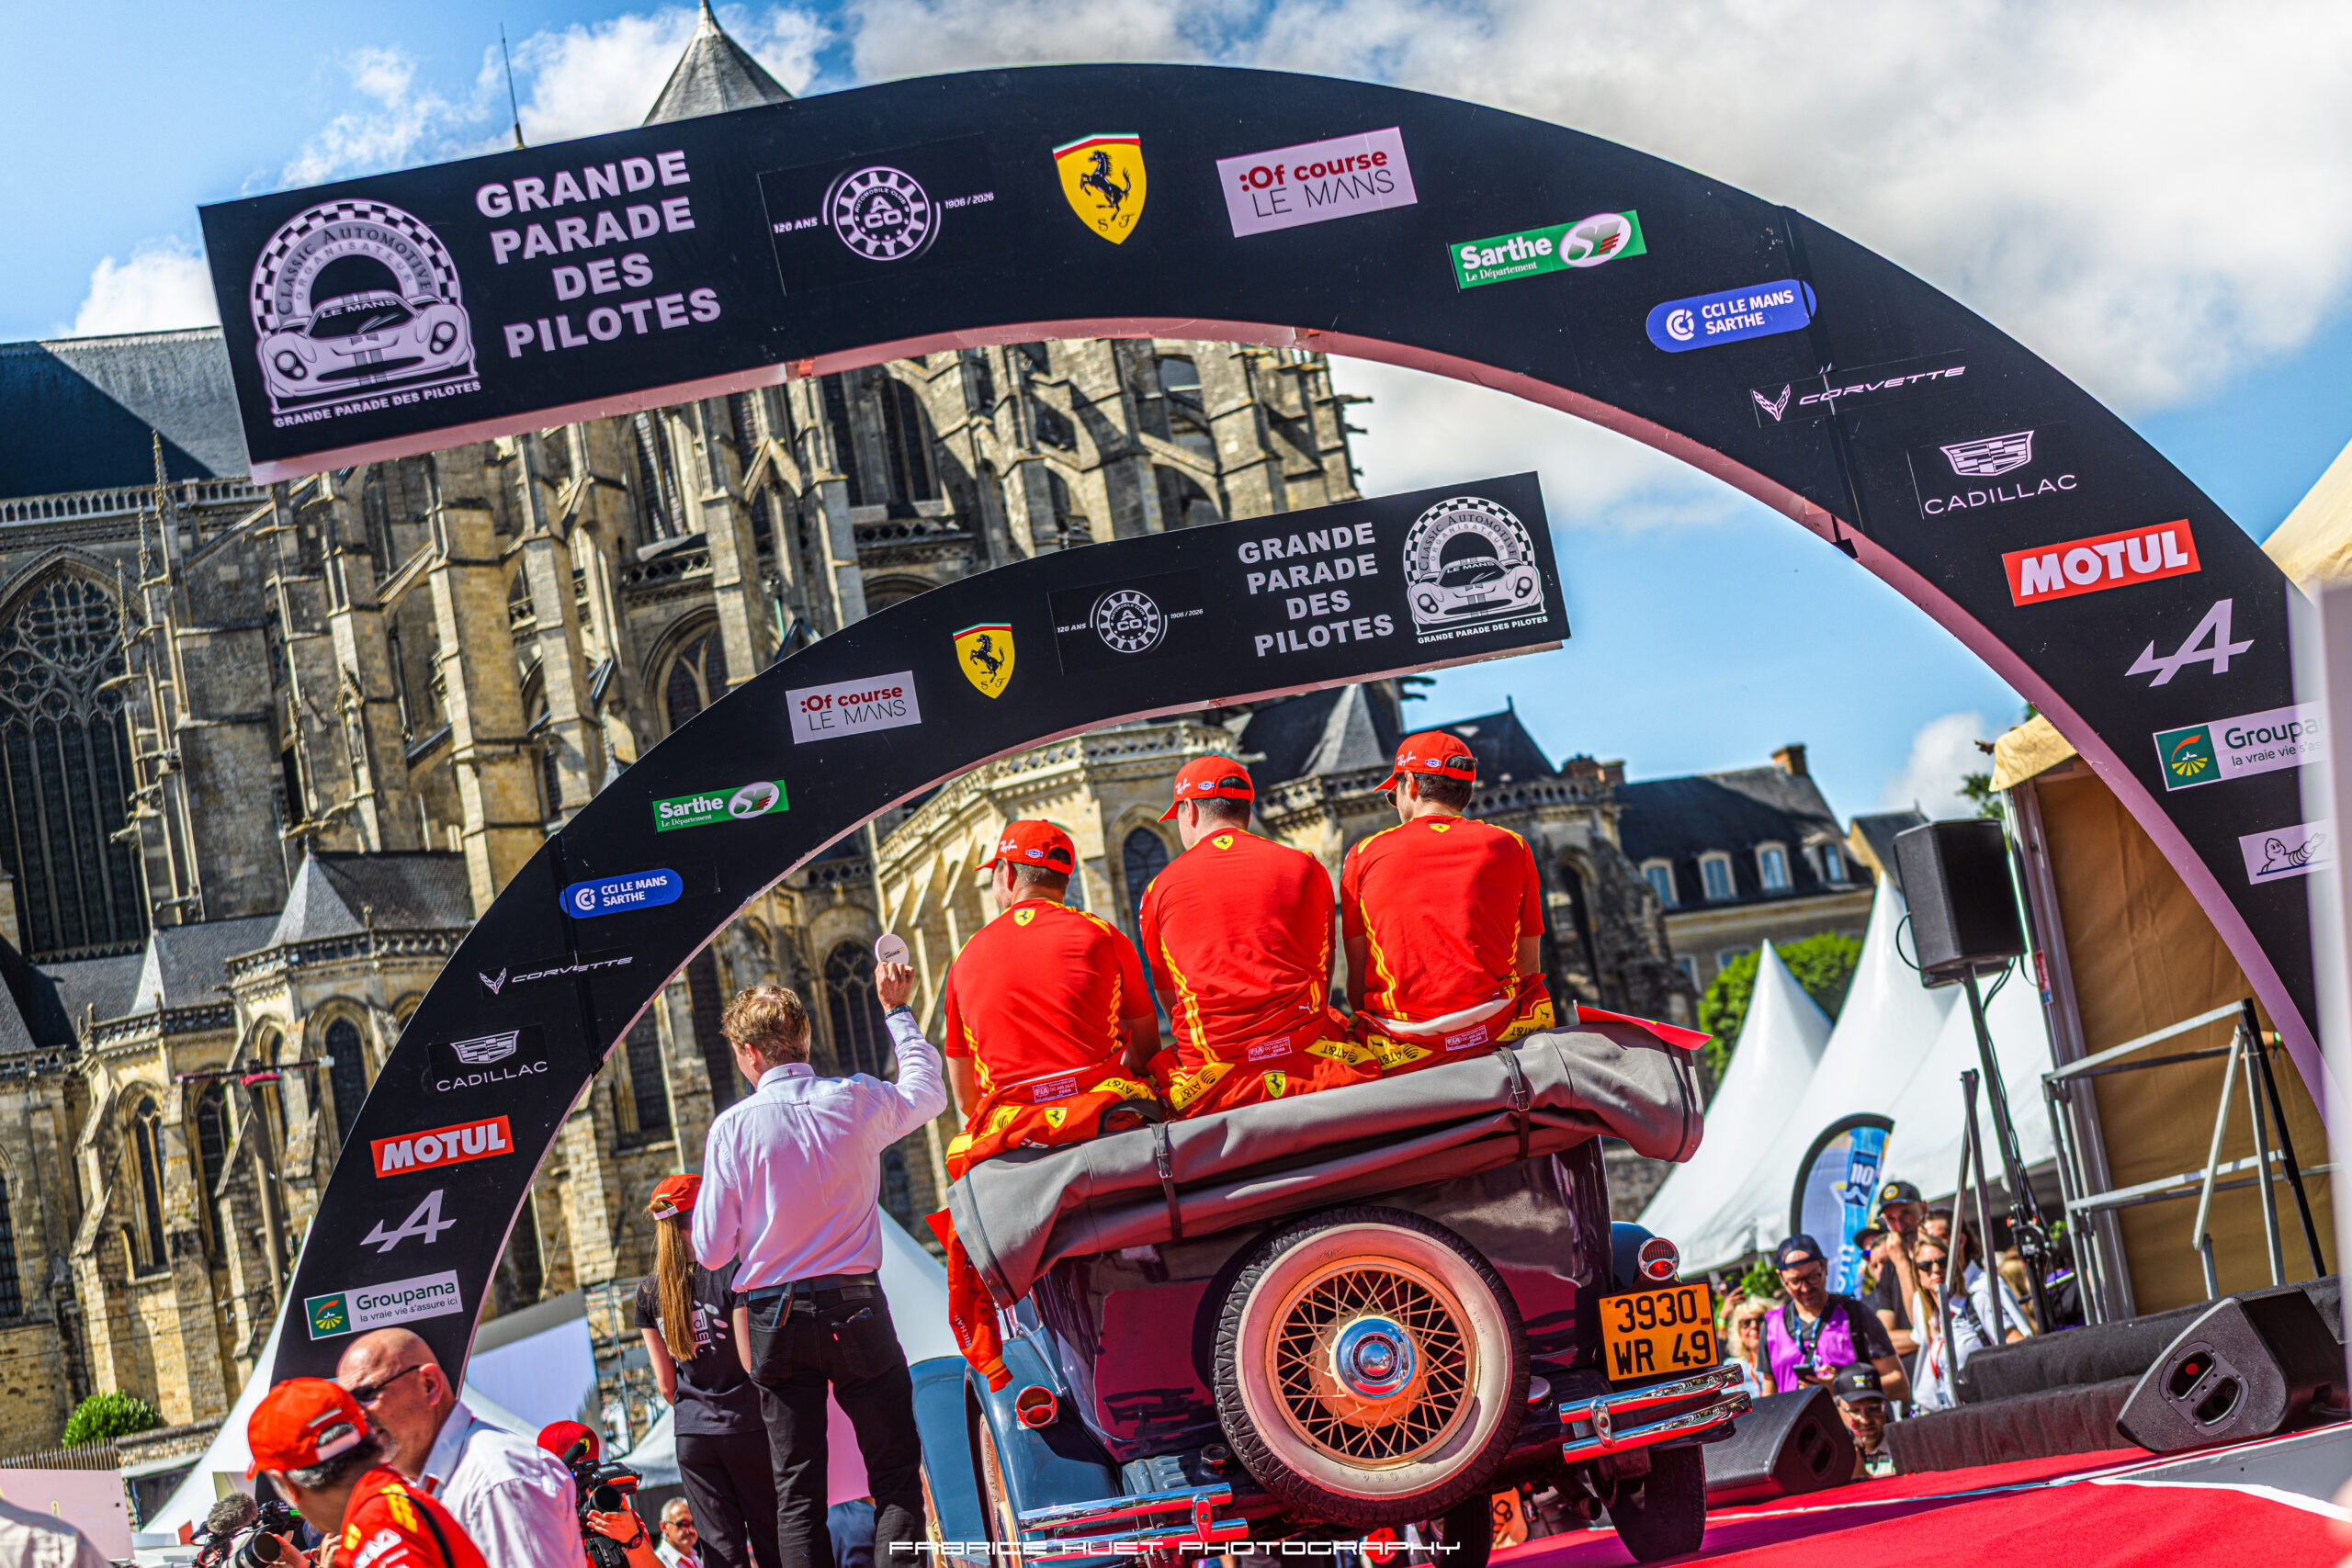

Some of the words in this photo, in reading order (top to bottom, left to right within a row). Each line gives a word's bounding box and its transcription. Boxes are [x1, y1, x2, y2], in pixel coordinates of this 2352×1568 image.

[1294, 151, 1388, 182] course
[476, 150, 691, 219] GRANDE
[854, 187, 889, 213] AUTOMOBILE
[890, 189, 907, 205] CLUB
[1252, 188, 1293, 218] LE
[1304, 169, 1395, 209] MANS
[773, 221, 792, 234] 120
[795, 217, 819, 230] ANS
[944, 197, 966, 209] 1906
[973, 191, 994, 204] 2026
[1098, 218, 1108, 232] S
[490, 196, 695, 265] PARADE
[1460, 236, 1553, 270] Sarthe
[277, 243, 317, 315] CLASSIC
[323, 226, 433, 290] AUTOMOTIVE
[296, 242, 413, 300] ORGANISATEUR
[551, 253, 653, 301] DES
[1464, 270, 1478, 283] Le
[1479, 261, 1538, 279] Département
[322, 308, 342, 319] LE
[346, 299, 398, 312] MANS
[1702, 302, 1726, 320] CCI
[1728, 299, 1747, 314] LE
[1749, 289, 1794, 310] MANS
[503, 288, 721, 359] PILOTES
[1705, 311, 1765, 335] SARTHE
[1799, 366, 1966, 406] CORVETTE
[274, 410, 331, 428] GRANDE
[334, 399, 390, 419] PARADE
[392, 392, 420, 408] DES
[424, 380, 481, 401] PILOTES
[1924, 474, 2077, 515] CADILLAC
[1238, 522, 1375, 564] GRANDE
[1419, 524, 1444, 570] CLASSIC
[1448, 513, 1517, 556] AUTOMOTIVE
[1430, 523, 1505, 561] ORGANISATEUR
[1247, 553, 1379, 594] PARADE
[1447, 566, 1460, 574] LE
[1463, 561, 1495, 570] MANS
[2020, 530, 2188, 597] MOTUL
[1286, 589, 1351, 620] DES
[1057, 625, 1069, 633] 120
[1070, 622, 1087, 631] ANS
[1170, 611, 1184, 619] 1906
[1188, 608, 1204, 617] 2026
[1254, 614, 1395, 657] PILOTES
[1418, 631, 1453, 645] GRANDE
[1455, 626, 1491, 638] PARADE
[1492, 623, 1510, 633] DES
[1511, 615, 1548, 629] PILOTES
[838, 686, 903, 707] course
[808, 710, 835, 731] LE
[843, 699, 907, 726] MANS
[2224, 717, 2324, 750] Groupa
[2232, 755, 2243, 767] la
[2245, 750, 2276, 764] vraie
[2278, 746, 2296, 757] vie
[2300, 740, 2323, 753] s'as
[659, 795, 723, 819] Sarthe
[662, 819, 670, 828] Le
[671, 814, 712, 827] Département
[601, 884, 618, 896] CCI
[620, 882, 634, 892] LE
[635, 875, 668, 889] MANS
[603, 890, 646, 907] SARTHE
[512, 956, 633, 983] CORVETTE
[1320, 1044, 1349, 1060] AT&T
[436, 1061, 548, 1092] CADILLAC
[1104, 1078, 1134, 1095] AT&T
[1180, 1081, 1202, 1102] AT&T
[382, 1122, 506, 1172] MOTUL
[1849, 1162, 1875, 1187] 110
[356, 1281, 456, 1311] Groupama
[360, 1314, 368, 1323] la
[370, 1309, 393, 1321] vraie
[394, 1306, 409, 1316] vie
[410, 1301, 446, 1314] s'assure
[447, 1297, 458, 1306] ici
[1614, 1289, 1697, 1333] 3930
[1613, 1338, 1655, 1376] WR
[1672, 1330, 1712, 1367] 49
